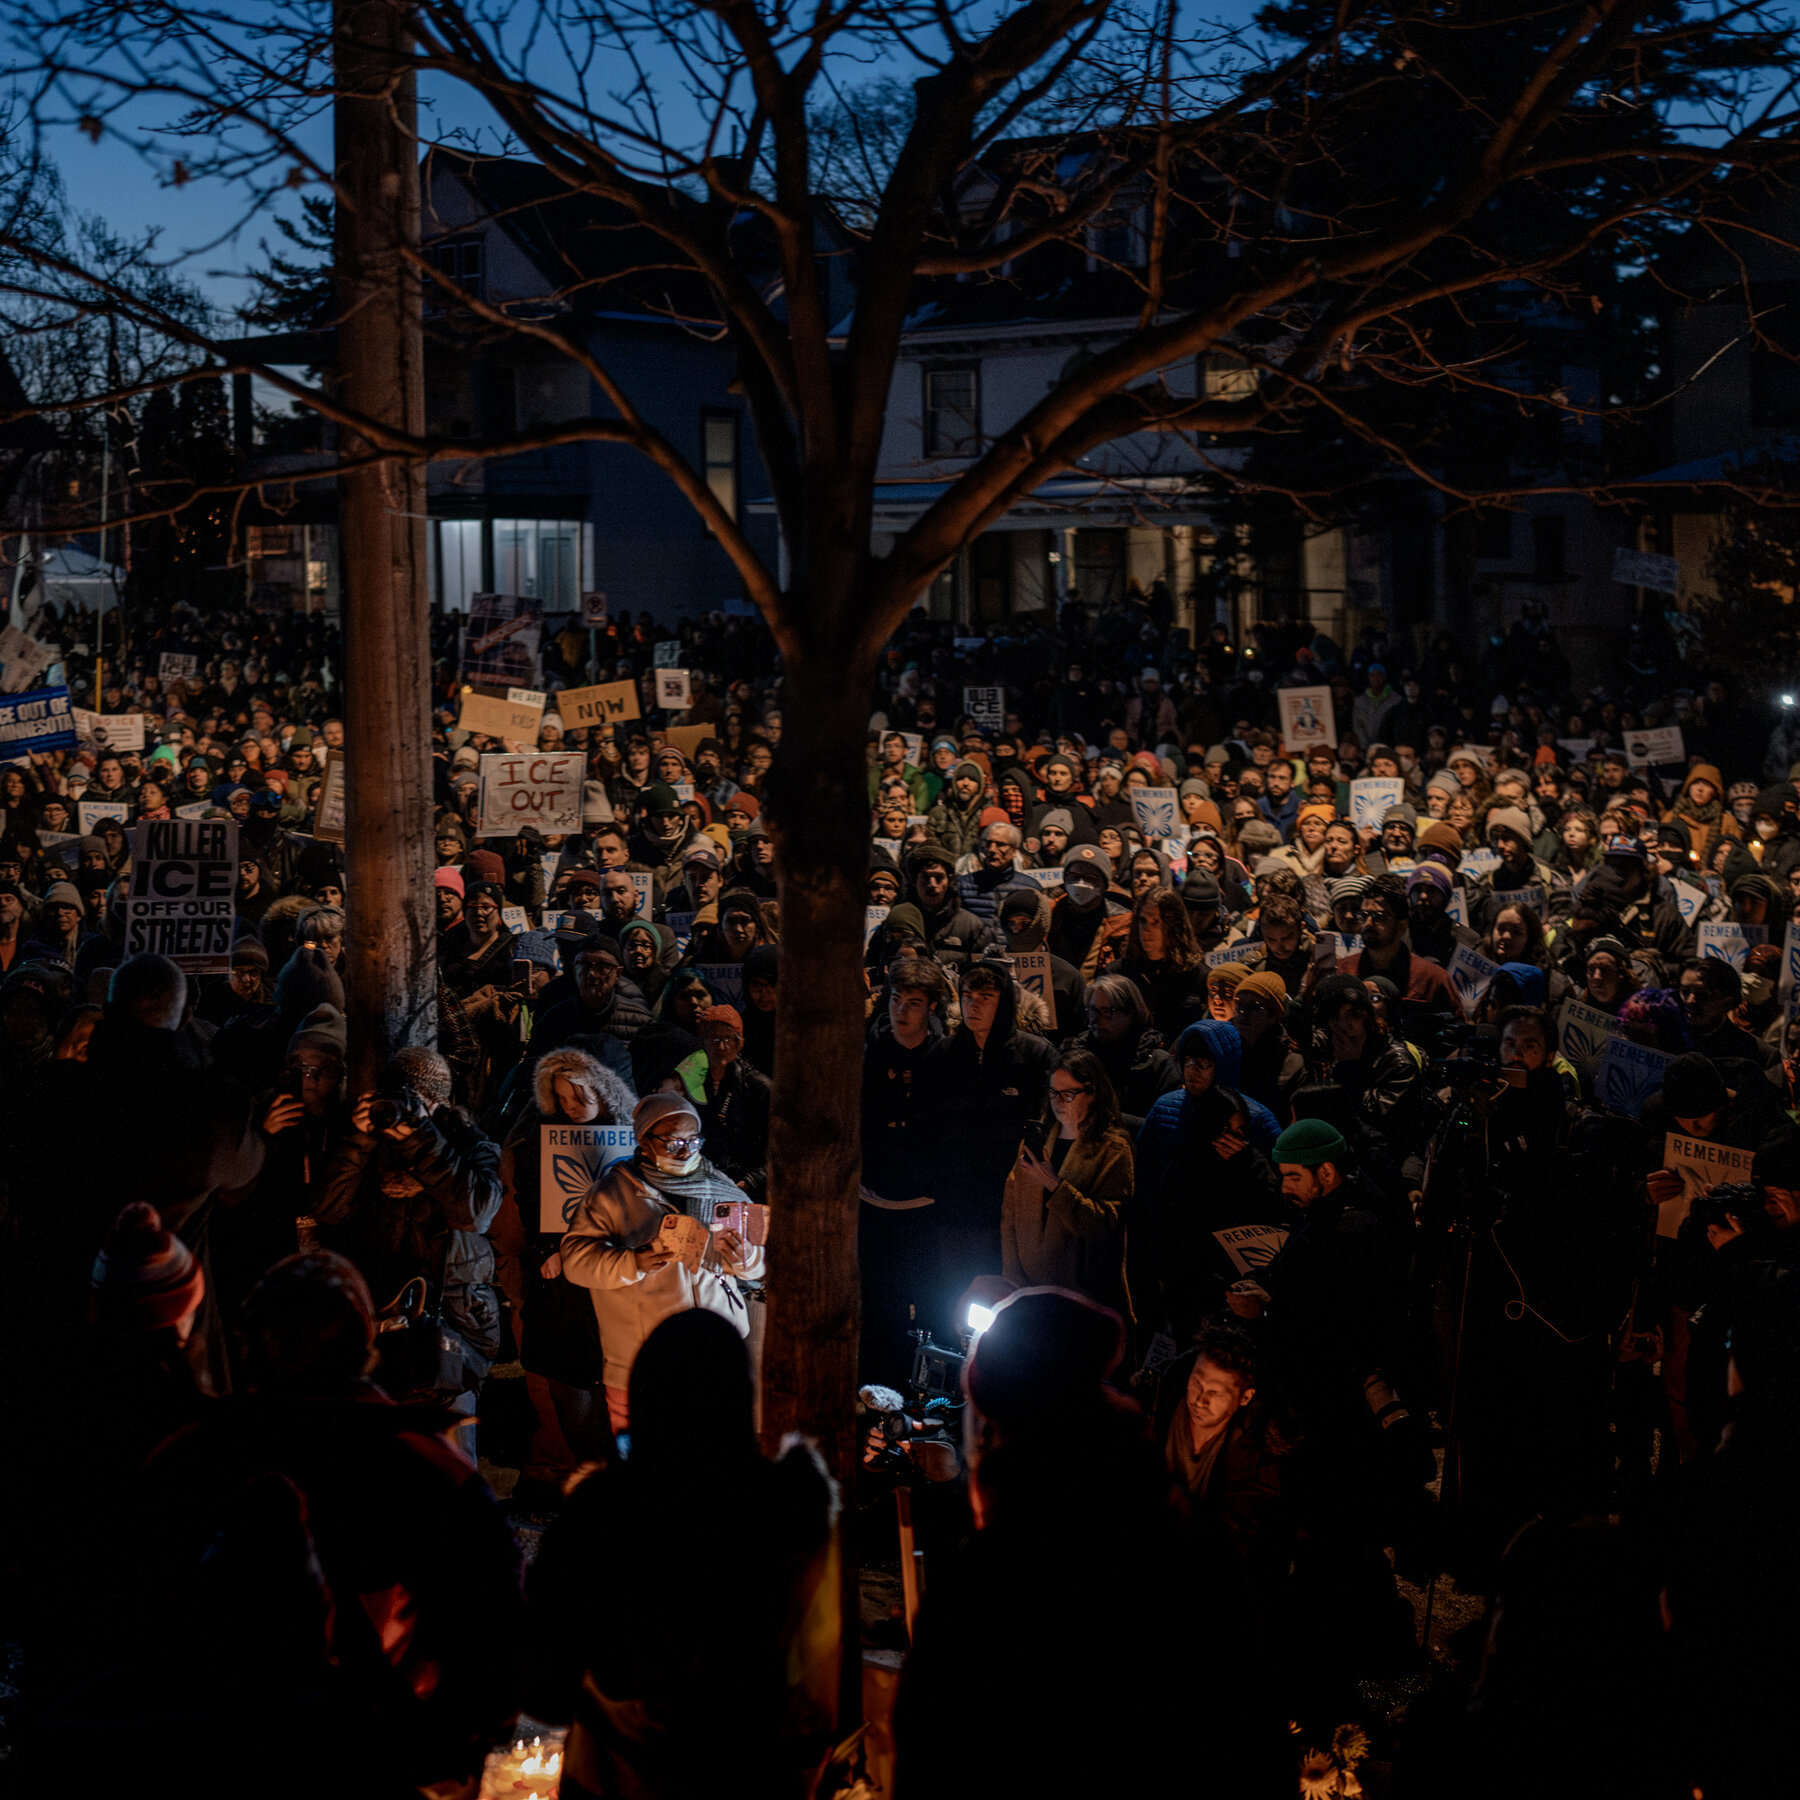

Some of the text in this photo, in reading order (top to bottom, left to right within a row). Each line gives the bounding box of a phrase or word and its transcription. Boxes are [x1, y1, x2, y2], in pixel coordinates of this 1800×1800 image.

[17, 699, 48, 721] OUT
[49, 696, 69, 715] OF
[115, 716, 135, 726] ICE
[577, 698, 624, 720] NOW
[498, 760, 570, 786] ICE
[1353, 781, 1401, 790] REMEMBER
[511, 789, 564, 811] OUT
[1132, 788, 1174, 798] REMEMBER
[146, 822, 227, 860] KILLER
[133, 862, 232, 897] ICE
[132, 901, 232, 916] OFF OUR
[129, 918, 232, 955] STREETS
[1014, 957, 1045, 969] MBER
[1460, 949, 1496, 977] REMEM
[1567, 1003, 1617, 1032] REMEM
[1673, 1138, 1751, 1170] REMEMBE
